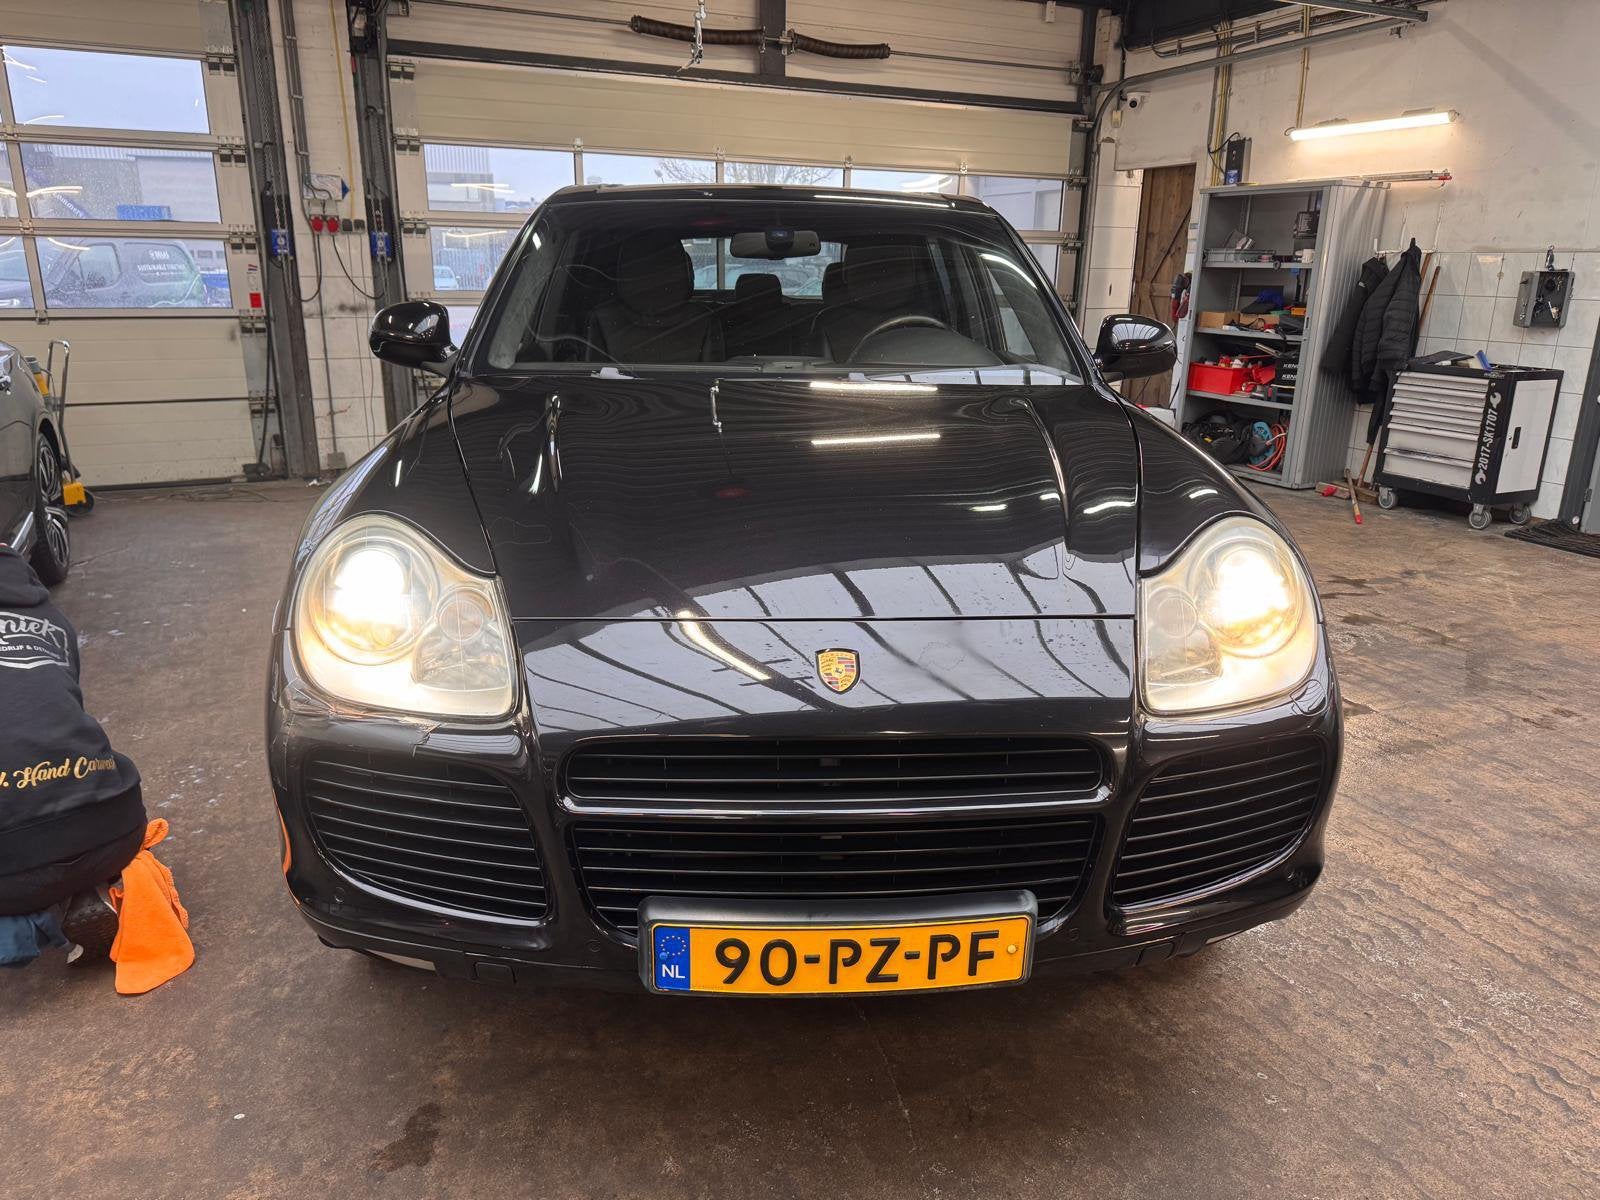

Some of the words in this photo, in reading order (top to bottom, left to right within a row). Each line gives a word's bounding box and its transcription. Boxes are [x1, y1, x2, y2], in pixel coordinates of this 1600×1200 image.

[1478, 408, 1498, 471] 2017-SK1707
[0, 644, 24, 652] DRIJF
[13, 758, 70, 789] Hand
[661, 963, 686, 979] NL
[715, 929, 1000, 986] 90-PZ-PF
